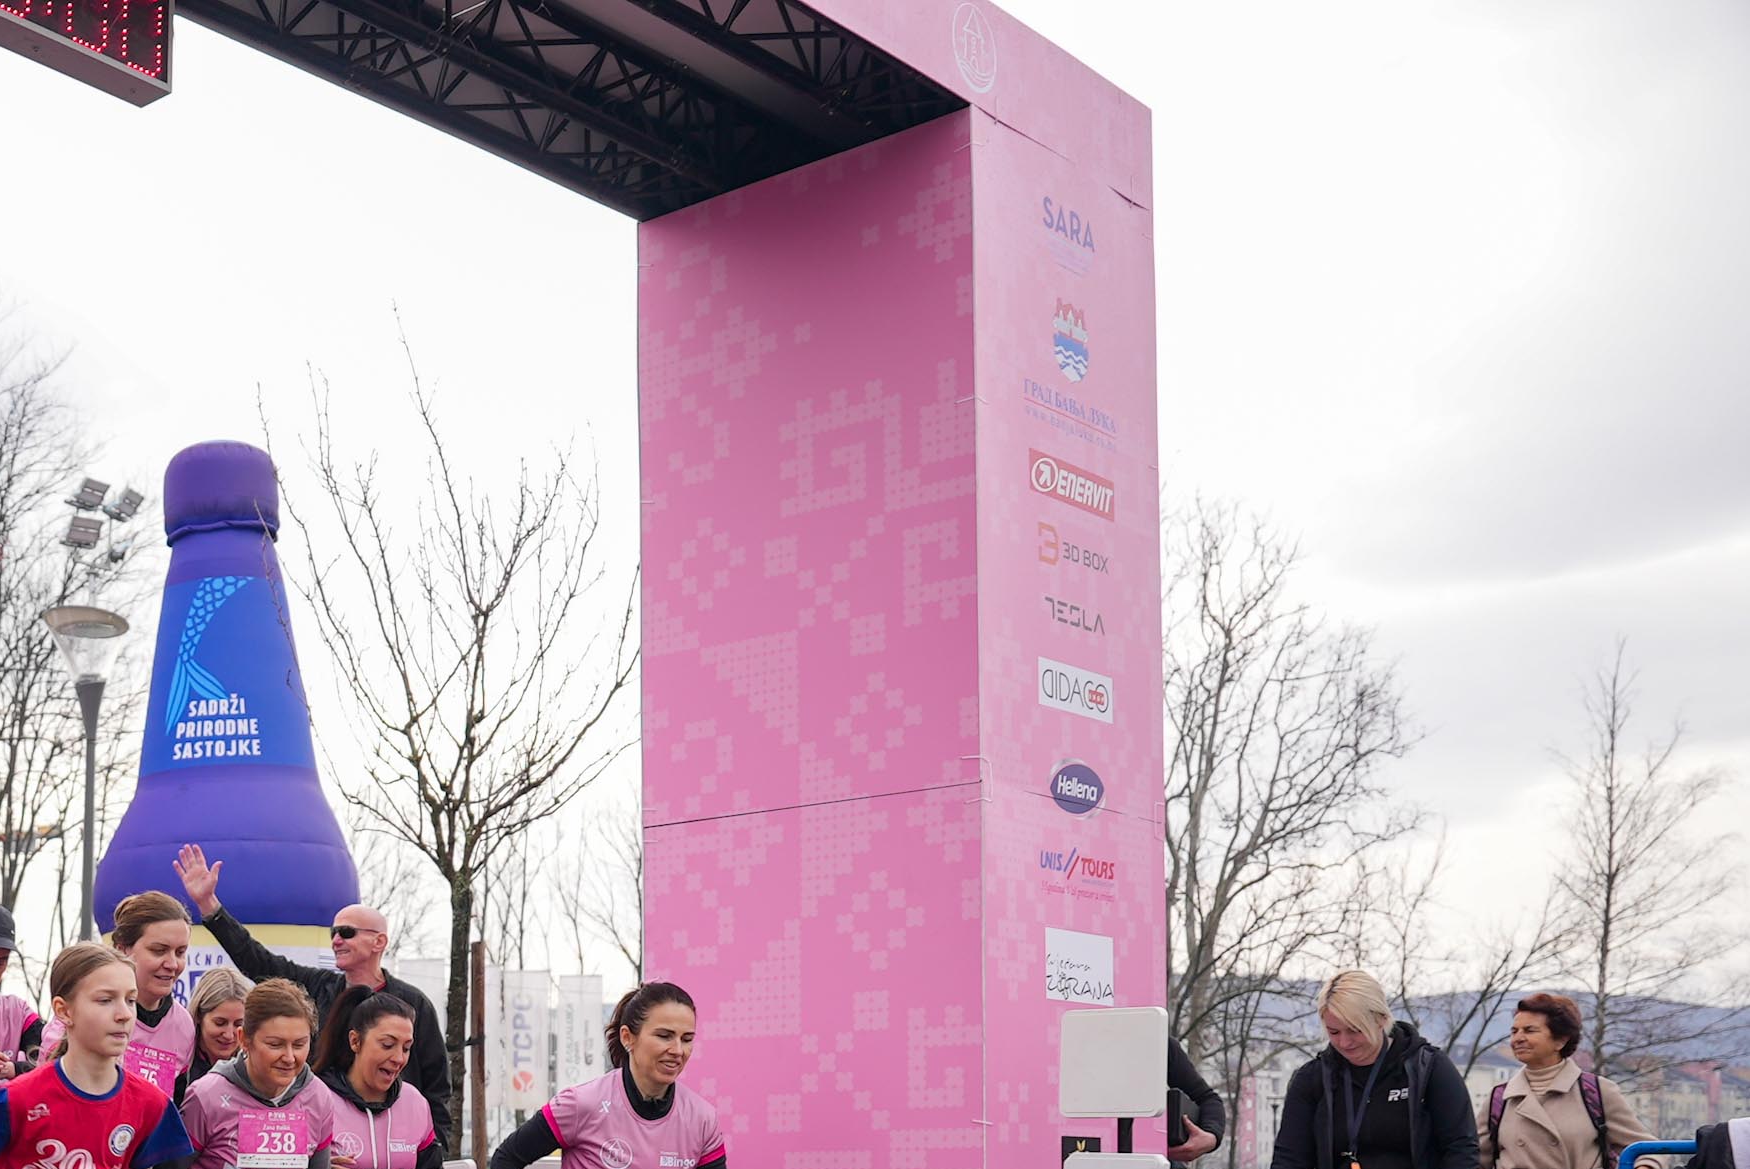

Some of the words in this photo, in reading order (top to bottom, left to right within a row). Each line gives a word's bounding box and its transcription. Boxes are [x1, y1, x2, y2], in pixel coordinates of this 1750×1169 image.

[1043, 196, 1095, 252] SARA
[1057, 471, 1113, 513] ENERVIT
[1062, 542, 1080, 563] 3D
[1083, 550, 1110, 574] BOX
[1045, 596, 1105, 635] TESLA
[188, 693, 246, 717] SADRŽI
[176, 718, 259, 739] PRIRODNE
[172, 739, 262, 760] SASTOJKE
[1057, 775, 1098, 802] Hellena
[1040, 850, 1063, 871] UNIS
[1081, 858, 1115, 879] TOURS
[257, 1132, 296, 1154] 238
[669, 1156, 696, 1169] Bingo
